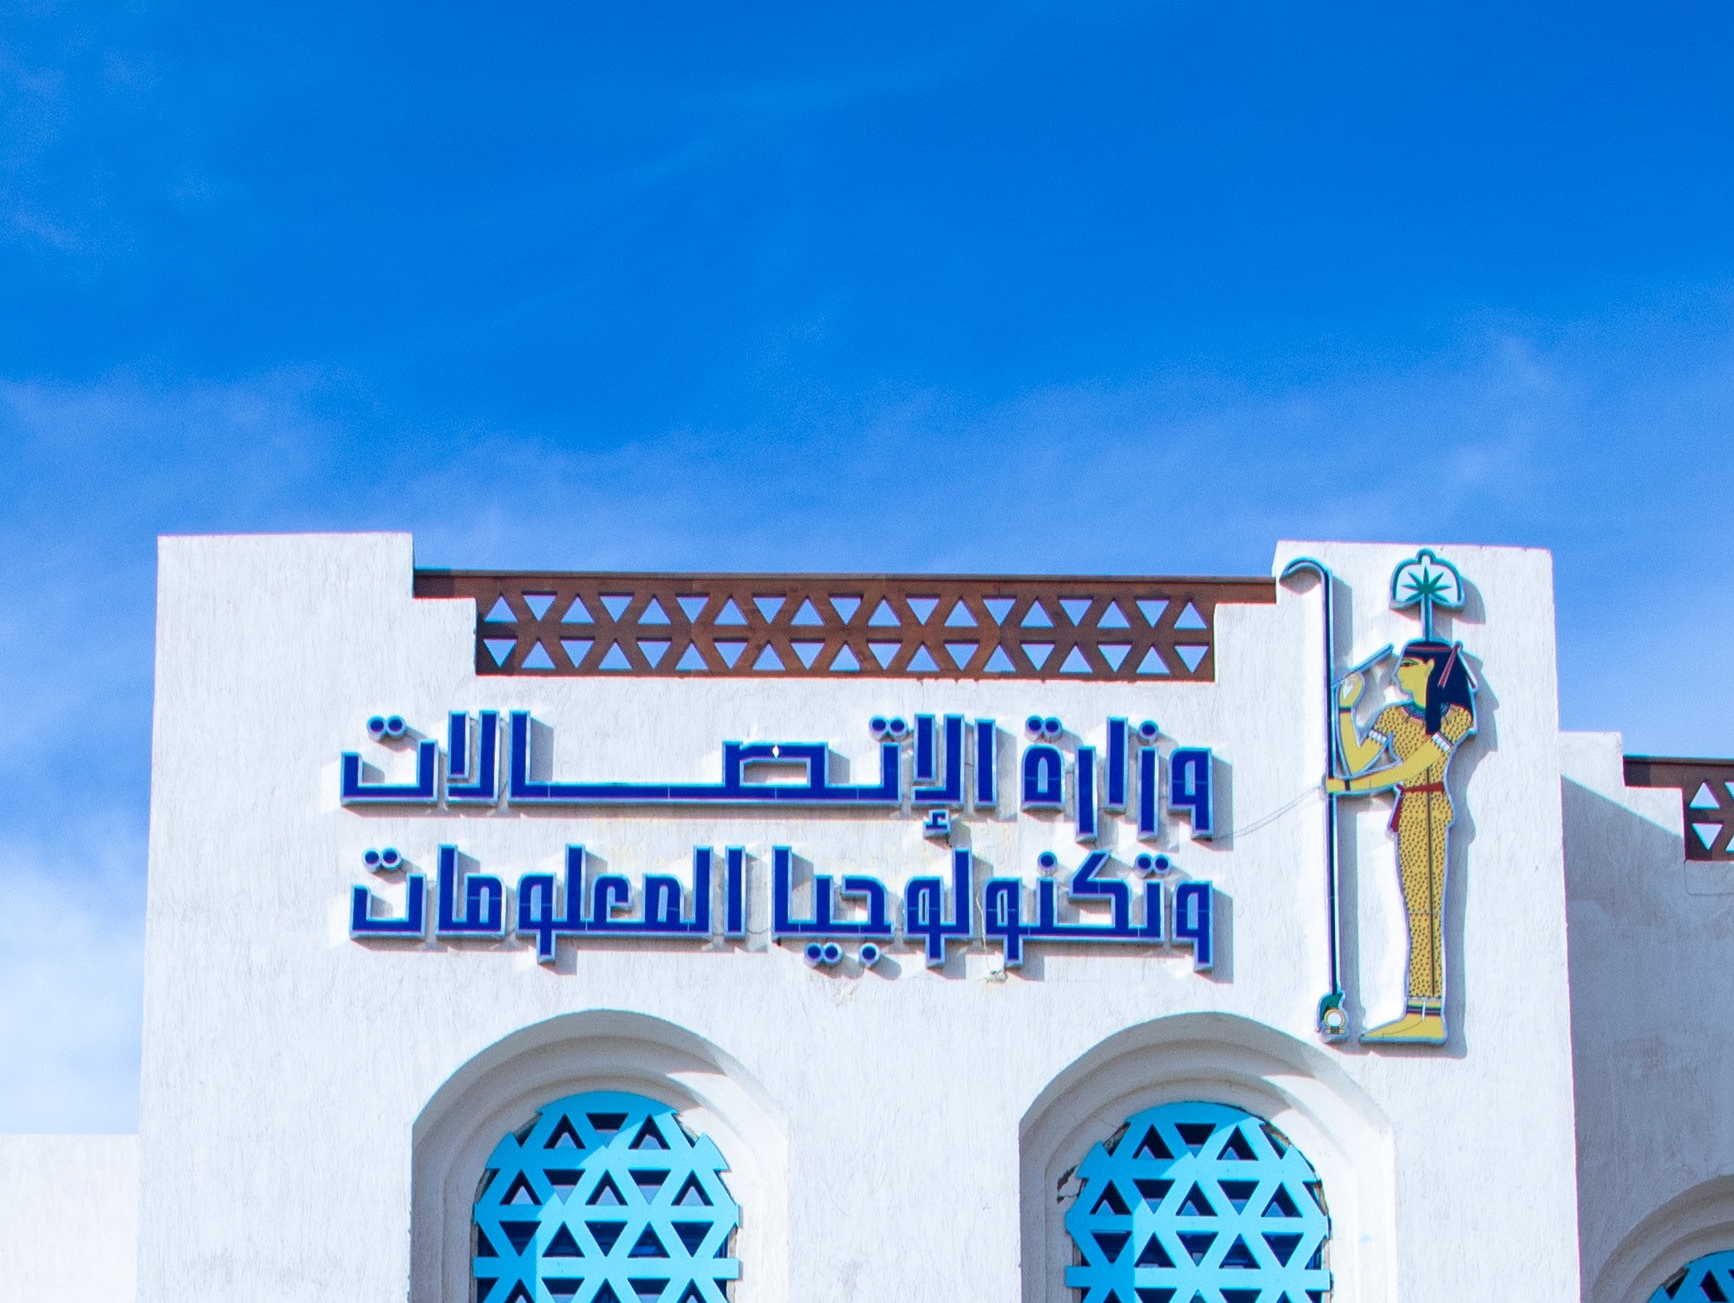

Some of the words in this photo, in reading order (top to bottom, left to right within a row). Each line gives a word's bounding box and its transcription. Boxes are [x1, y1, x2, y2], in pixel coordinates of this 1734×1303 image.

[1021, 714, 1213, 842] وزارة
[350, 843, 749, 965] المعلومات
[771, 848, 1214, 972] وتكنولوجيا
